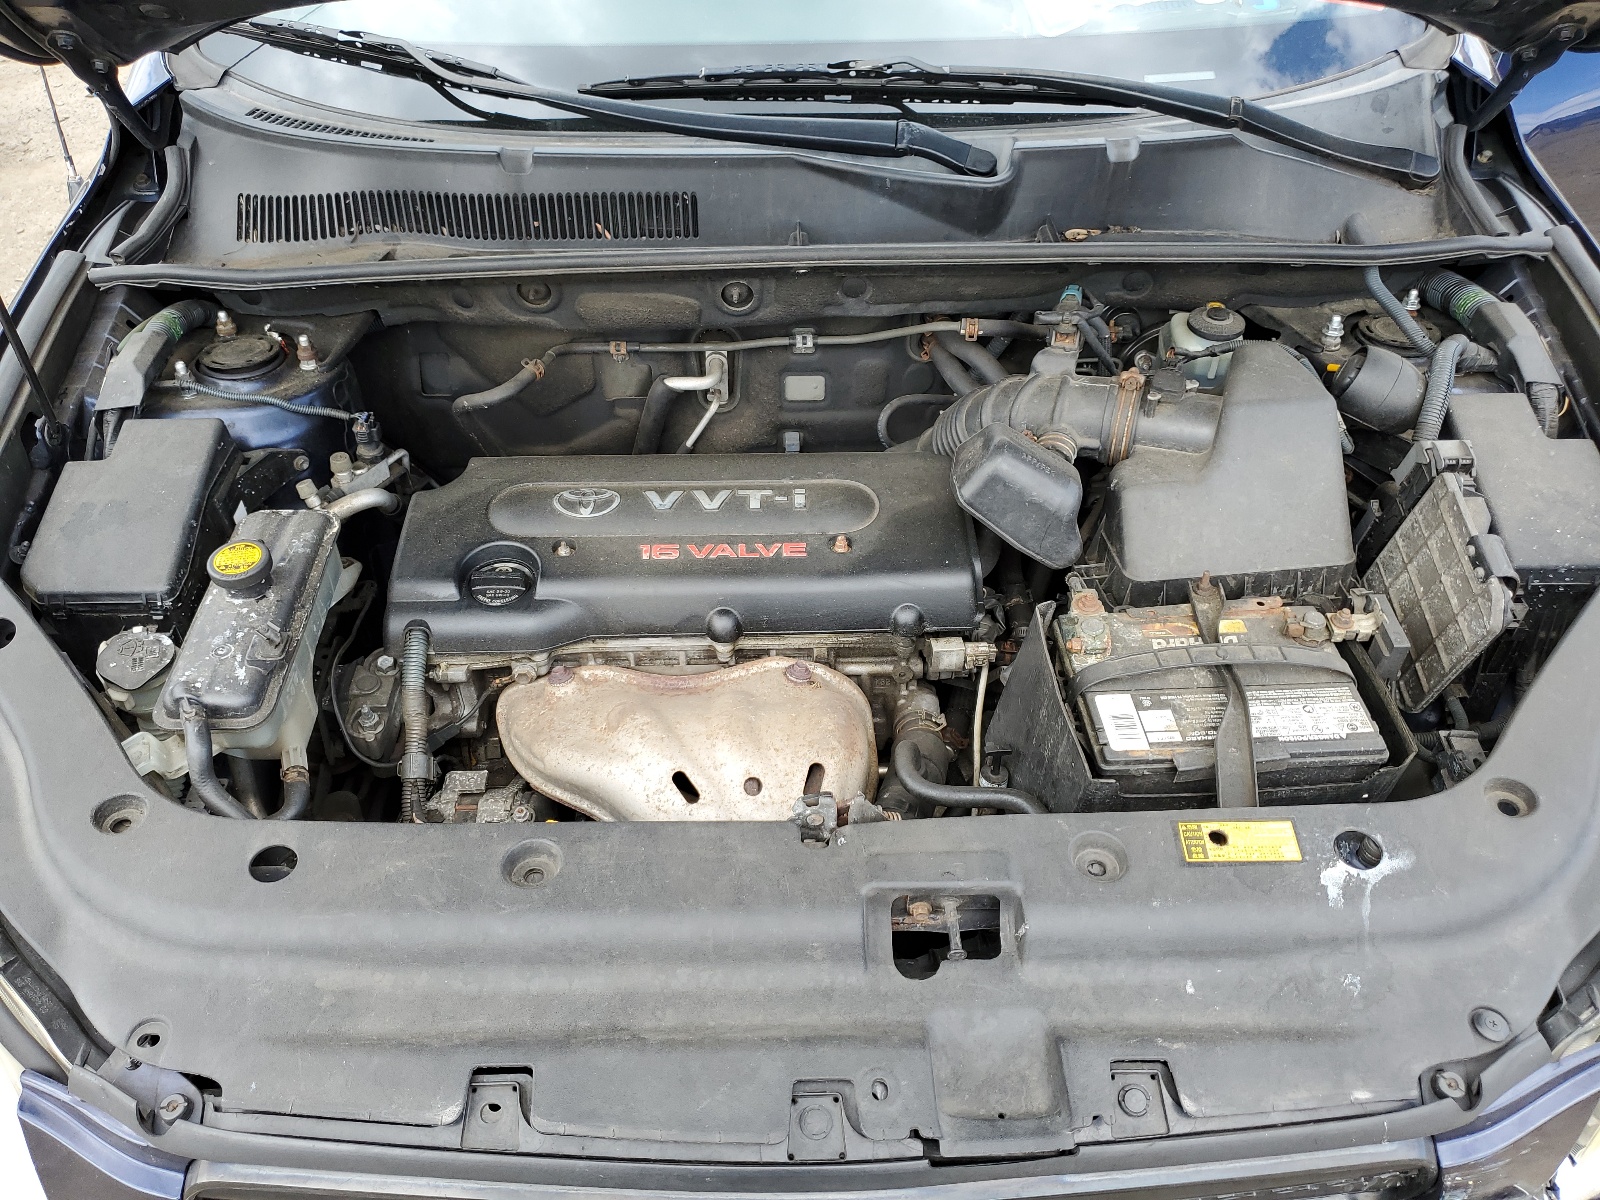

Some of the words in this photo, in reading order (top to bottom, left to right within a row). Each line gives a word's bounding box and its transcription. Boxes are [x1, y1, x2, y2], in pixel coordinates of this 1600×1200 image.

[643, 488, 807, 511] VVT-i
[640, 544, 681, 560] 16
[687, 542, 808, 559] VALVE
